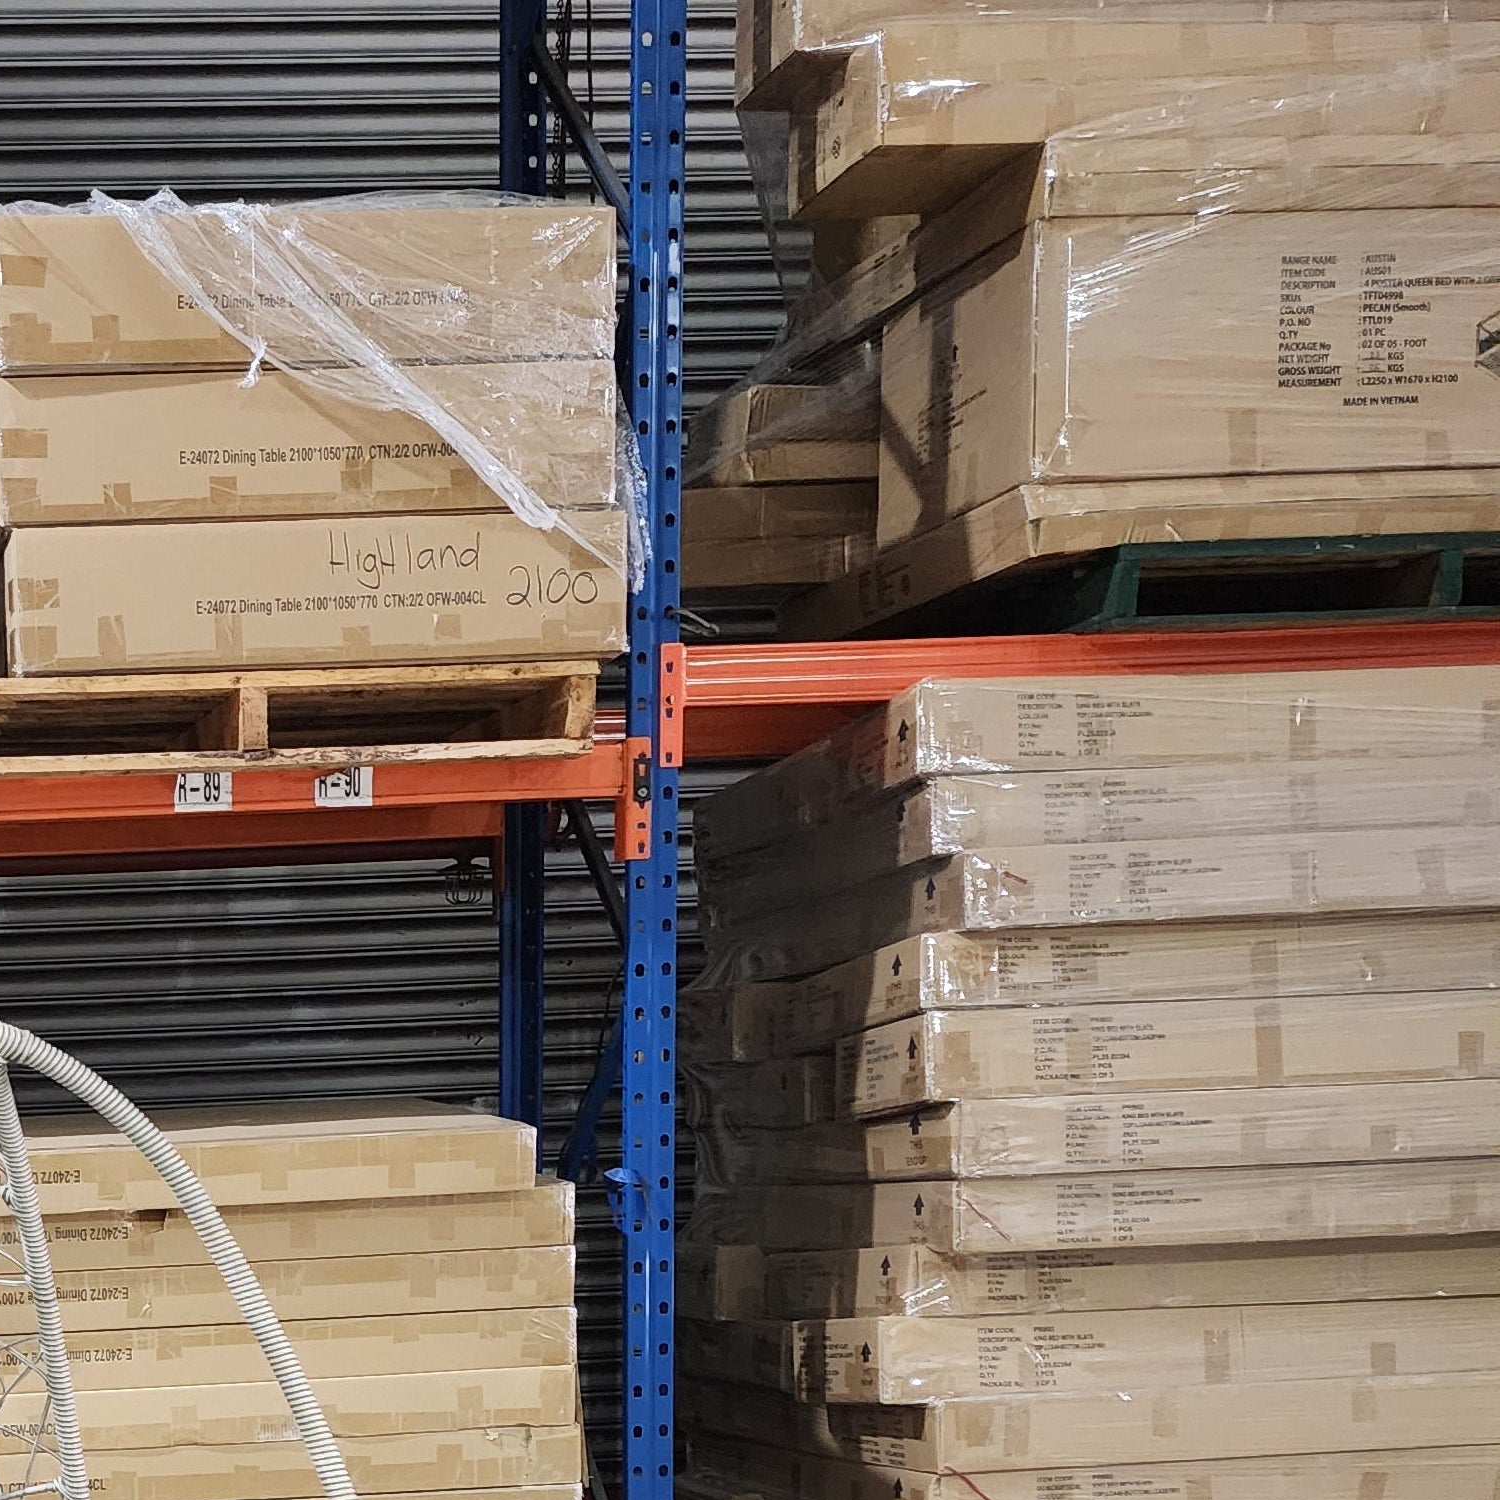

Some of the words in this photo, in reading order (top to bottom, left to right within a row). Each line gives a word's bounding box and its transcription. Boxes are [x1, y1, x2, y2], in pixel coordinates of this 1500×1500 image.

[1281, 255, 1310, 265] RANGE
[1312, 255, 1337, 264] NAME
[1365, 254, 1396, 263] AUSTIN
[1281, 268, 1301, 277] ITEM
[1303, 268, 1326, 277] CODE
[1281, 280, 1336, 290] DESCRIPTION
[1371, 278, 1402, 288] POSTER
[1405, 277, 1433, 287] QUEEN
[1435, 276, 1452, 286] BED
[1280, 305, 1315, 315] COLOUR
[1362, 303, 1391, 313] PECAN
[1393, 301, 1431, 313] (Smooth)
[1298, 317, 1311, 327] NO
[1374, 328, 1386, 336] PC
[1278, 342, 1318, 351] PACKAGE
[1319, 342, 1331, 351] No
[1362, 340, 1372, 348] 02
[1374, 340, 1385, 348] OF
[1387, 339, 1397, 348] 05
[1404, 339, 1427, 347] FOOT
[1278, 355, 1296, 364] NET
[1297, 354, 1329, 363] WEIGHT
[1387, 352, 1404, 360] KGS
[1278, 367, 1306, 376] GROSS
[1308, 366, 1341, 375] WEIGHT
[1387, 364, 1404, 372] KGS
[1278, 378, 1342, 388] MEASUREMENT
[1394, 375, 1423, 384] W1670
[1431, 374, 1459, 383] H2100
[1343, 397, 1368, 406] MADE
[1370, 397, 1379, 406] IN
[1380, 396, 1419, 405] VIETNAM
[180, 451, 220, 464] E-24072
[223, 450, 257, 467] Dining
[259, 449, 287, 463] Table
[369, 444, 410, 459] CTN:2/2
[412, 442, 460, 457] OFW-004
[506, 565, 599, 606] 2100
[196, 600, 236, 615] E-24072
[240, 599, 272, 616] Dining
[275, 597, 302, 613] Table
[384, 594, 424, 608] CTN:2/2
[427, 592, 487, 606] OFW-004CL
[178, 773, 220, 803] R-89
[319, 767, 361, 798] R-90
[41, 1170, 81, 1185] E-24072
[55, 1227, 88, 1243] Dining
[90, 1226, 129, 1241] E-24072
[55, 1287, 88, 1303] Dining
[90, 1286, 129, 1301] E-24072
[93, 1347, 132, 1361] E-24072
